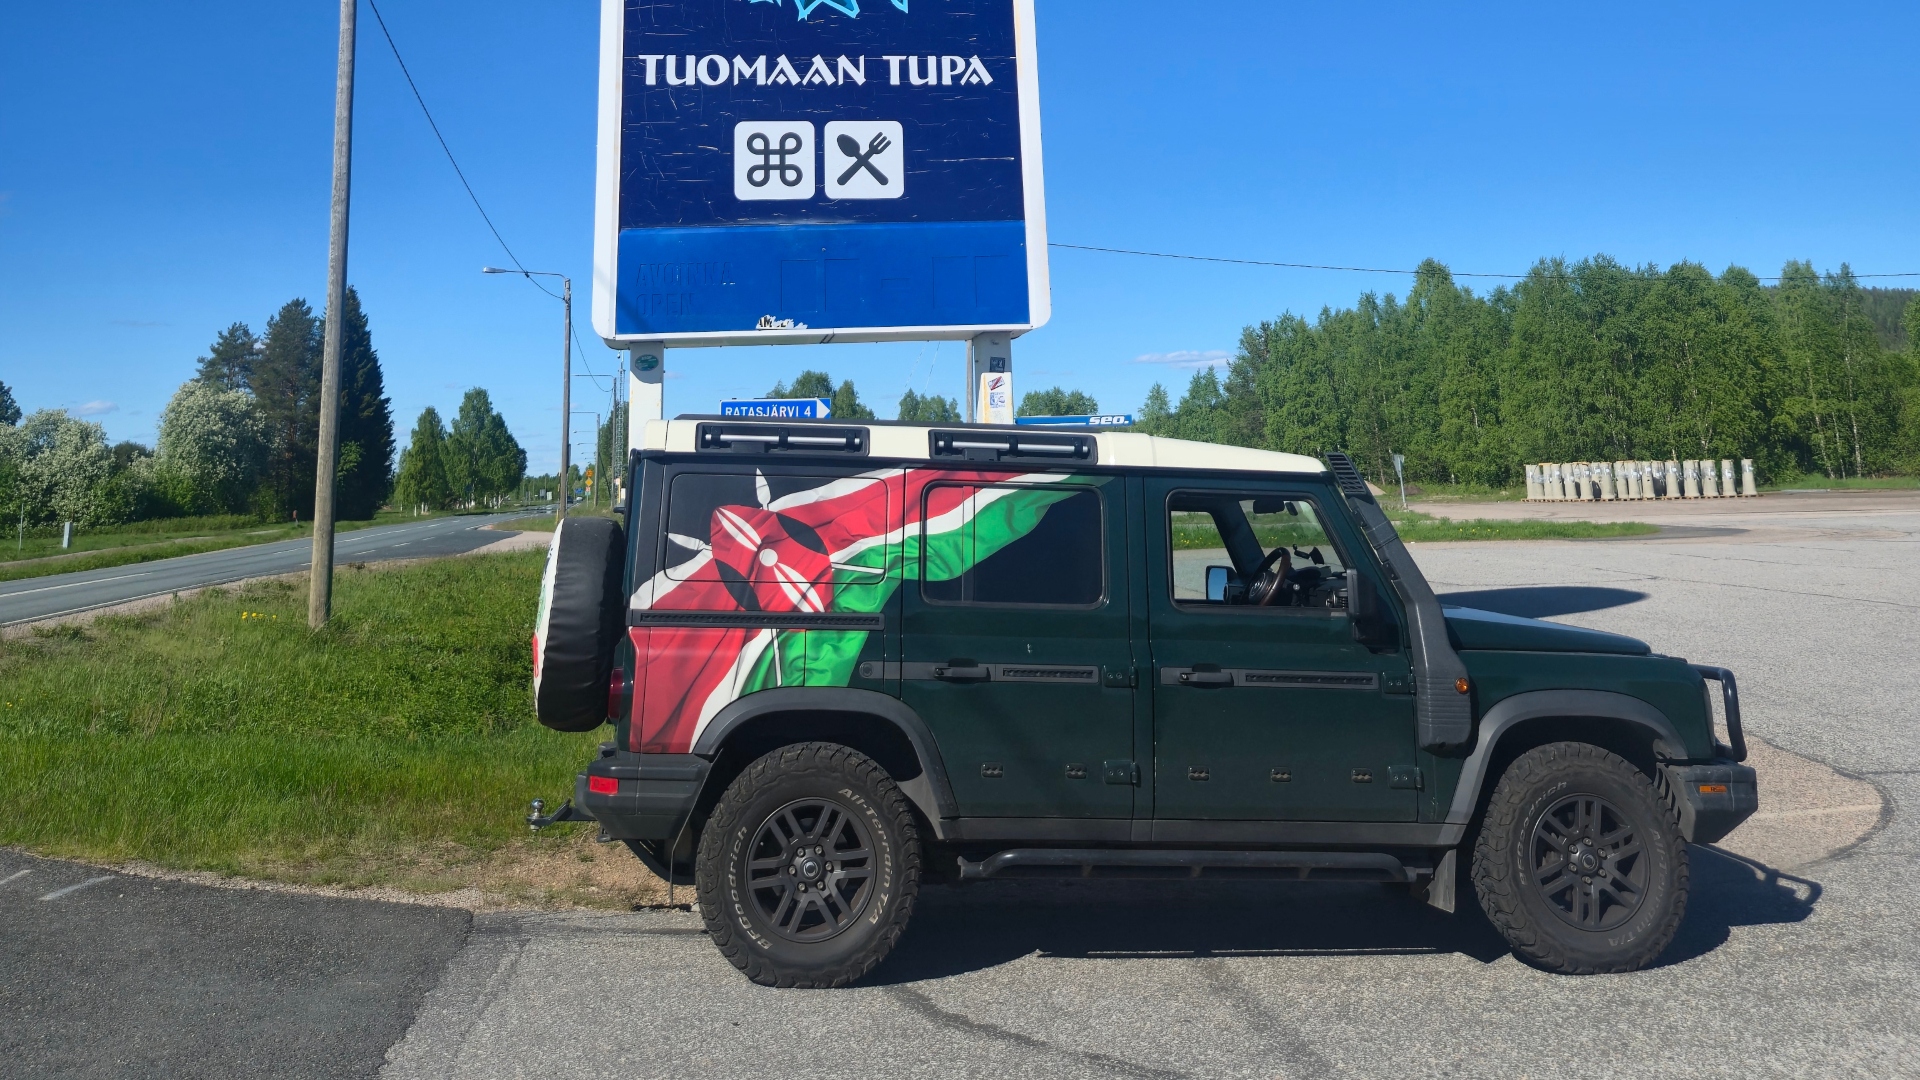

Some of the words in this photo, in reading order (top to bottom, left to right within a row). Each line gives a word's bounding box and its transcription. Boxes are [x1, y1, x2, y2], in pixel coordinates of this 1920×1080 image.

[638, 54, 865, 86] TUOMAAN
[883, 54, 994, 86] TUPA
[635, 293, 693, 316] OPEN
[725, 404, 799, 417] RATASJÄRVI
[804, 405, 811, 417] 4
[838, 788, 893, 889] All-Terrain
[868, 893, 889, 925] T/A
[728, 825, 773, 950] BFGoodrich
